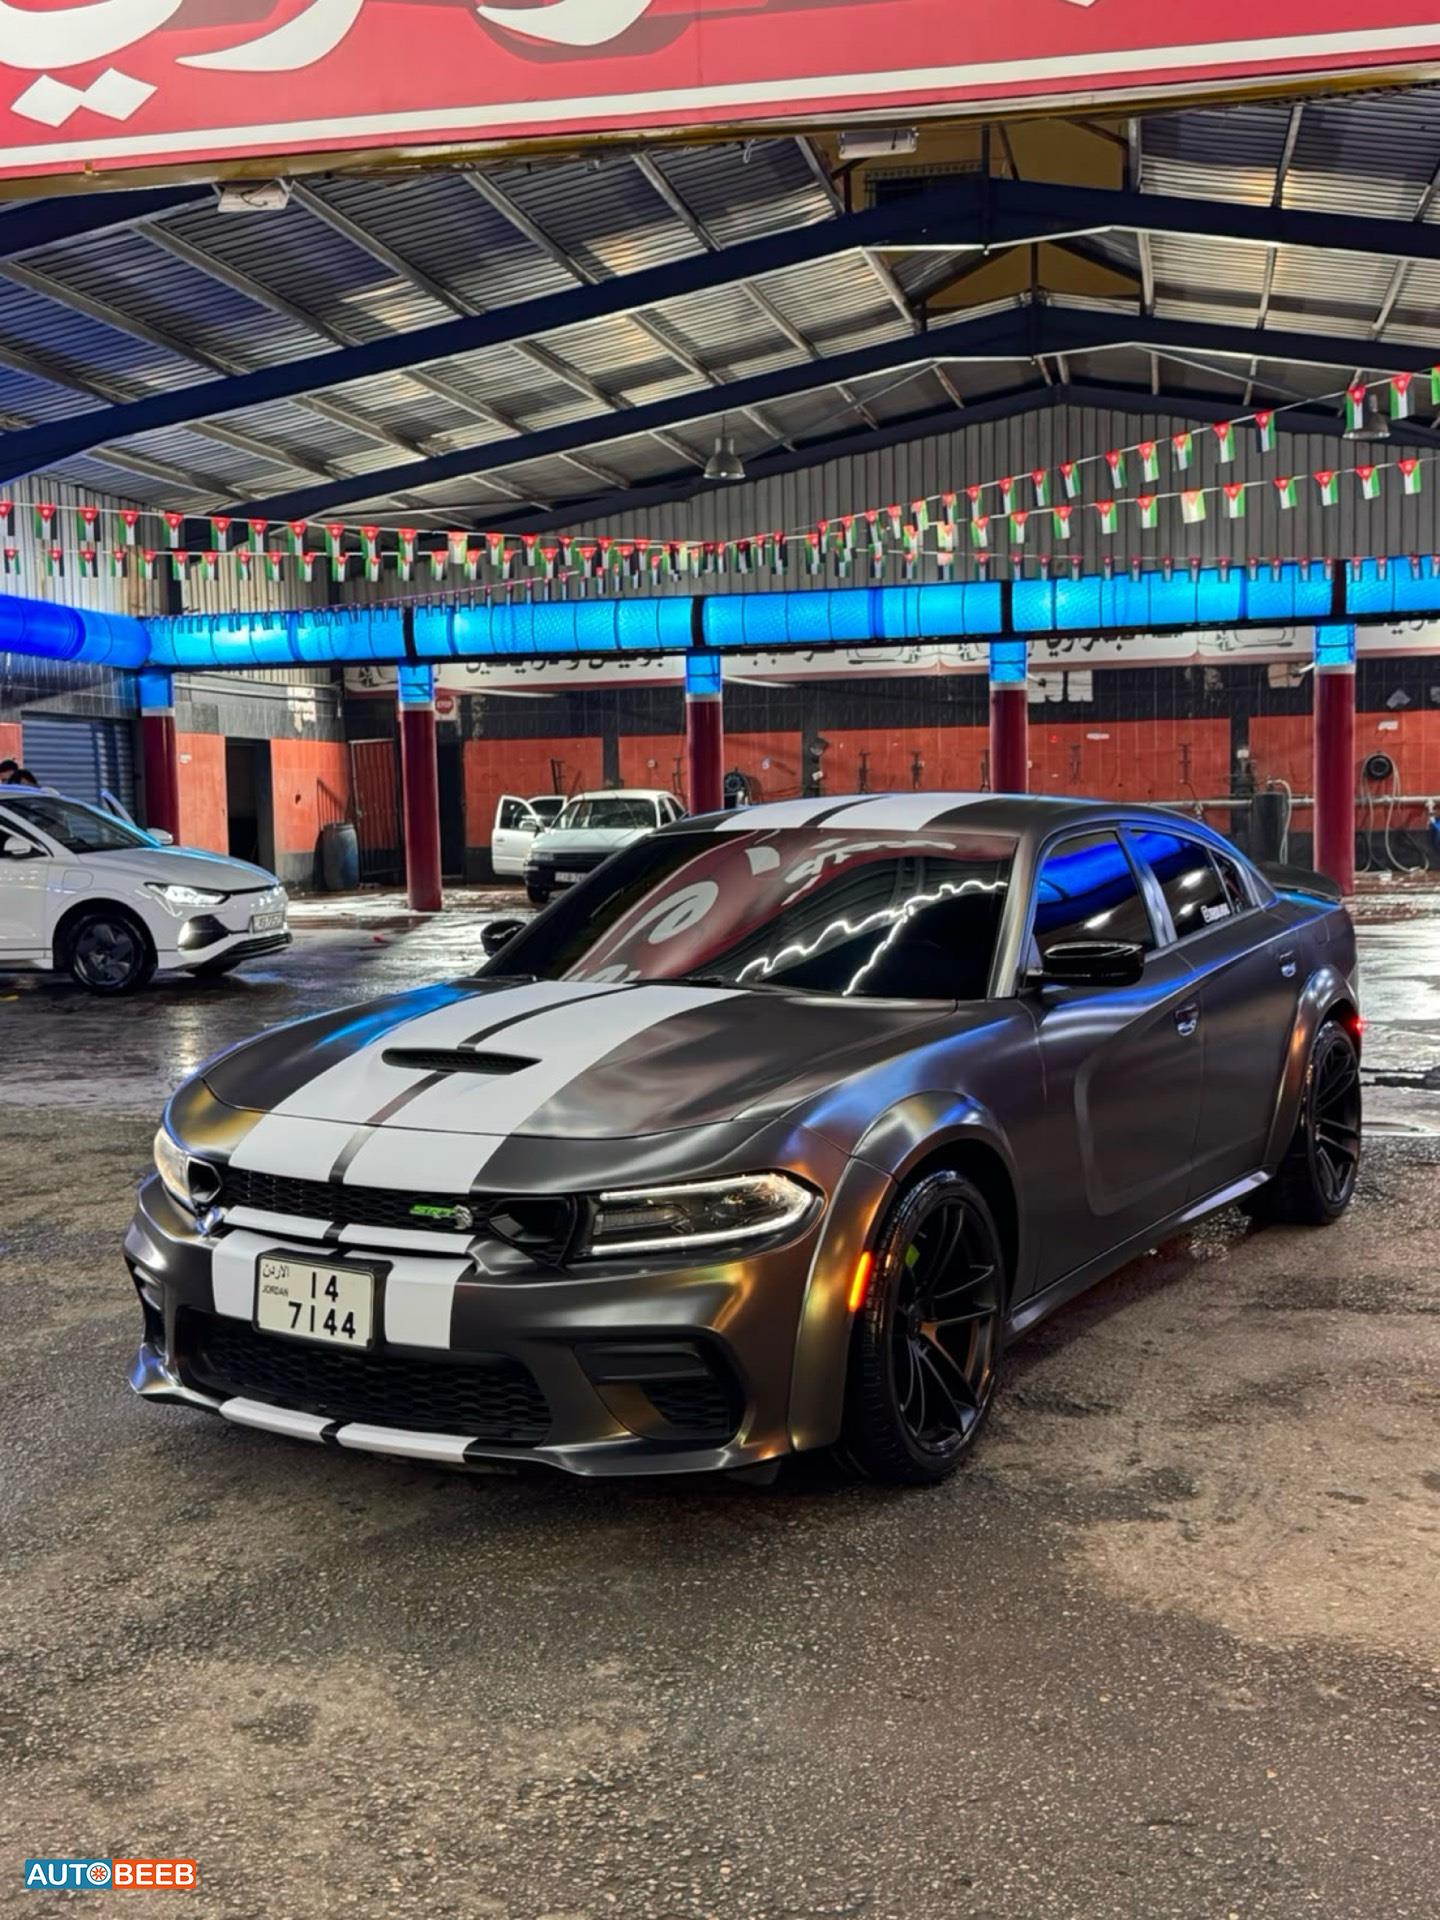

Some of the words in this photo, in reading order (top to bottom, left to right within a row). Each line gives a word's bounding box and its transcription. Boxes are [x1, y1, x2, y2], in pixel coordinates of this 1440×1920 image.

[262, 1285, 289, 1297] JORDAN
[311, 1271, 339, 1302] 14
[288, 1301, 356, 1339] 7144
